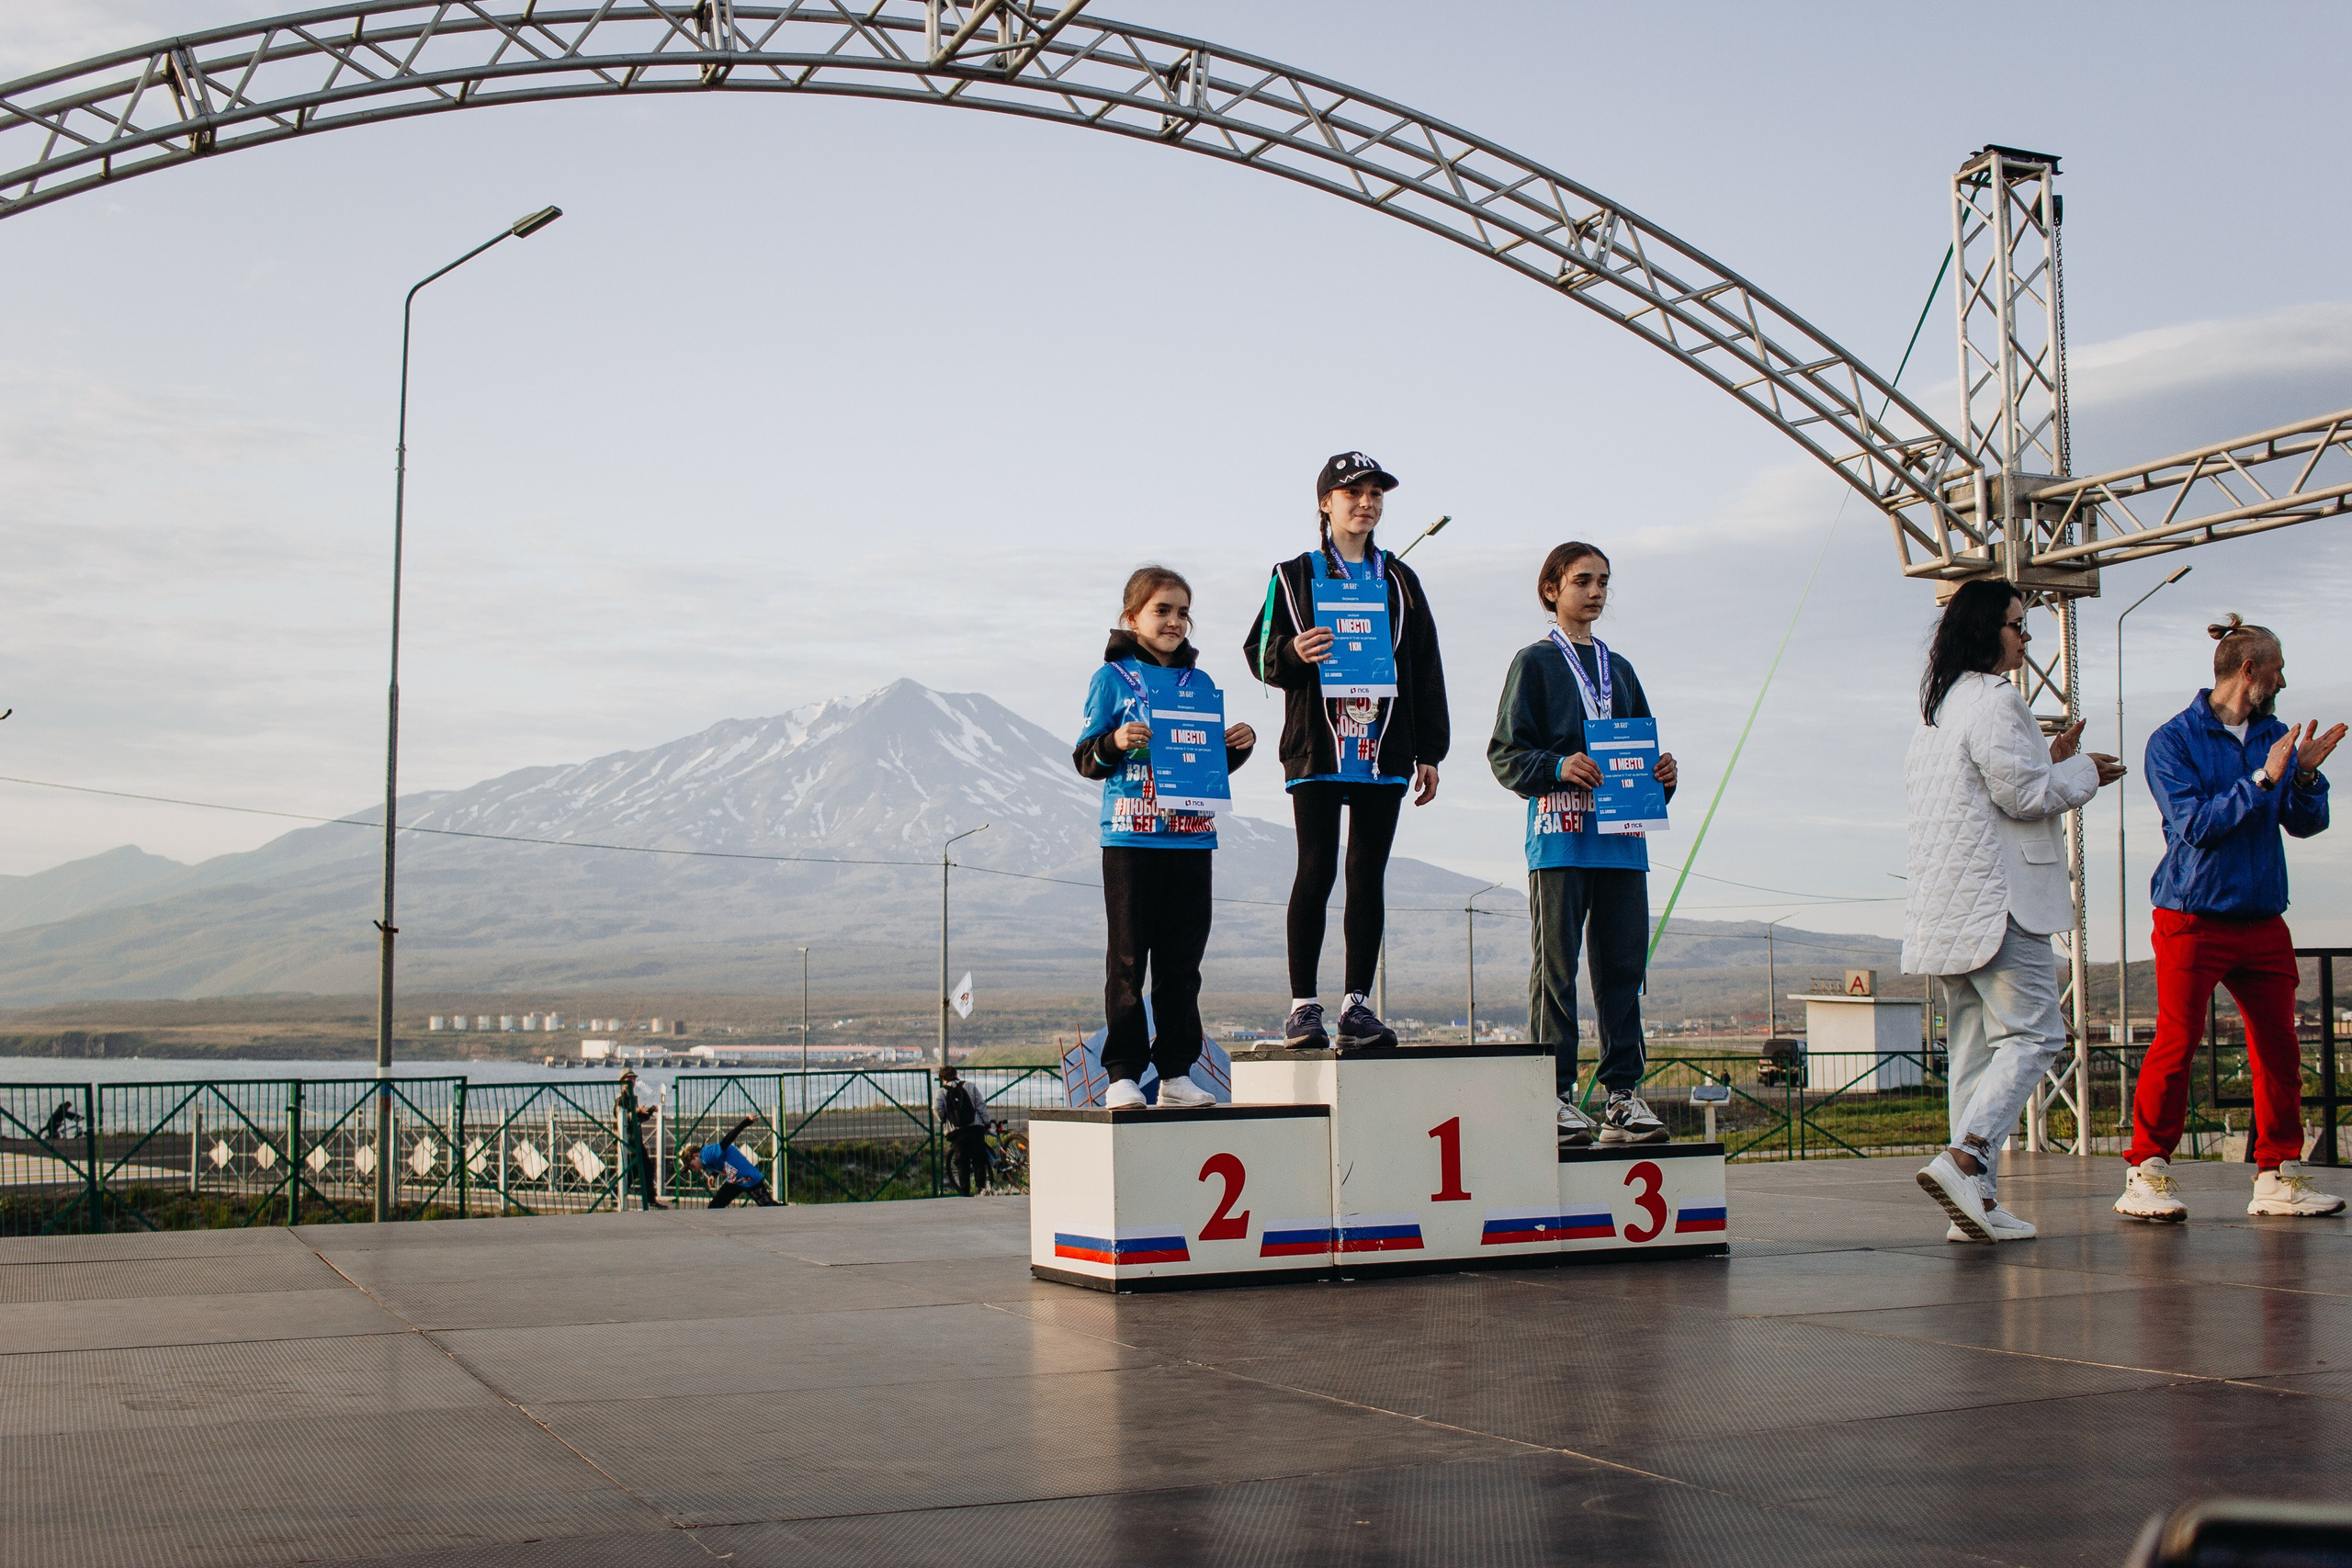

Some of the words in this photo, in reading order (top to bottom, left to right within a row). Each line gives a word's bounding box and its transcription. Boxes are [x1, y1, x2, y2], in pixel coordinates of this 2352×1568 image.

[1111, 815, 1157, 832] #ЗАБЕГ
[1198, 1153, 1250, 1241] 2
[1429, 1116, 1472, 1201] 1
[1623, 1160, 1667, 1243] 3
